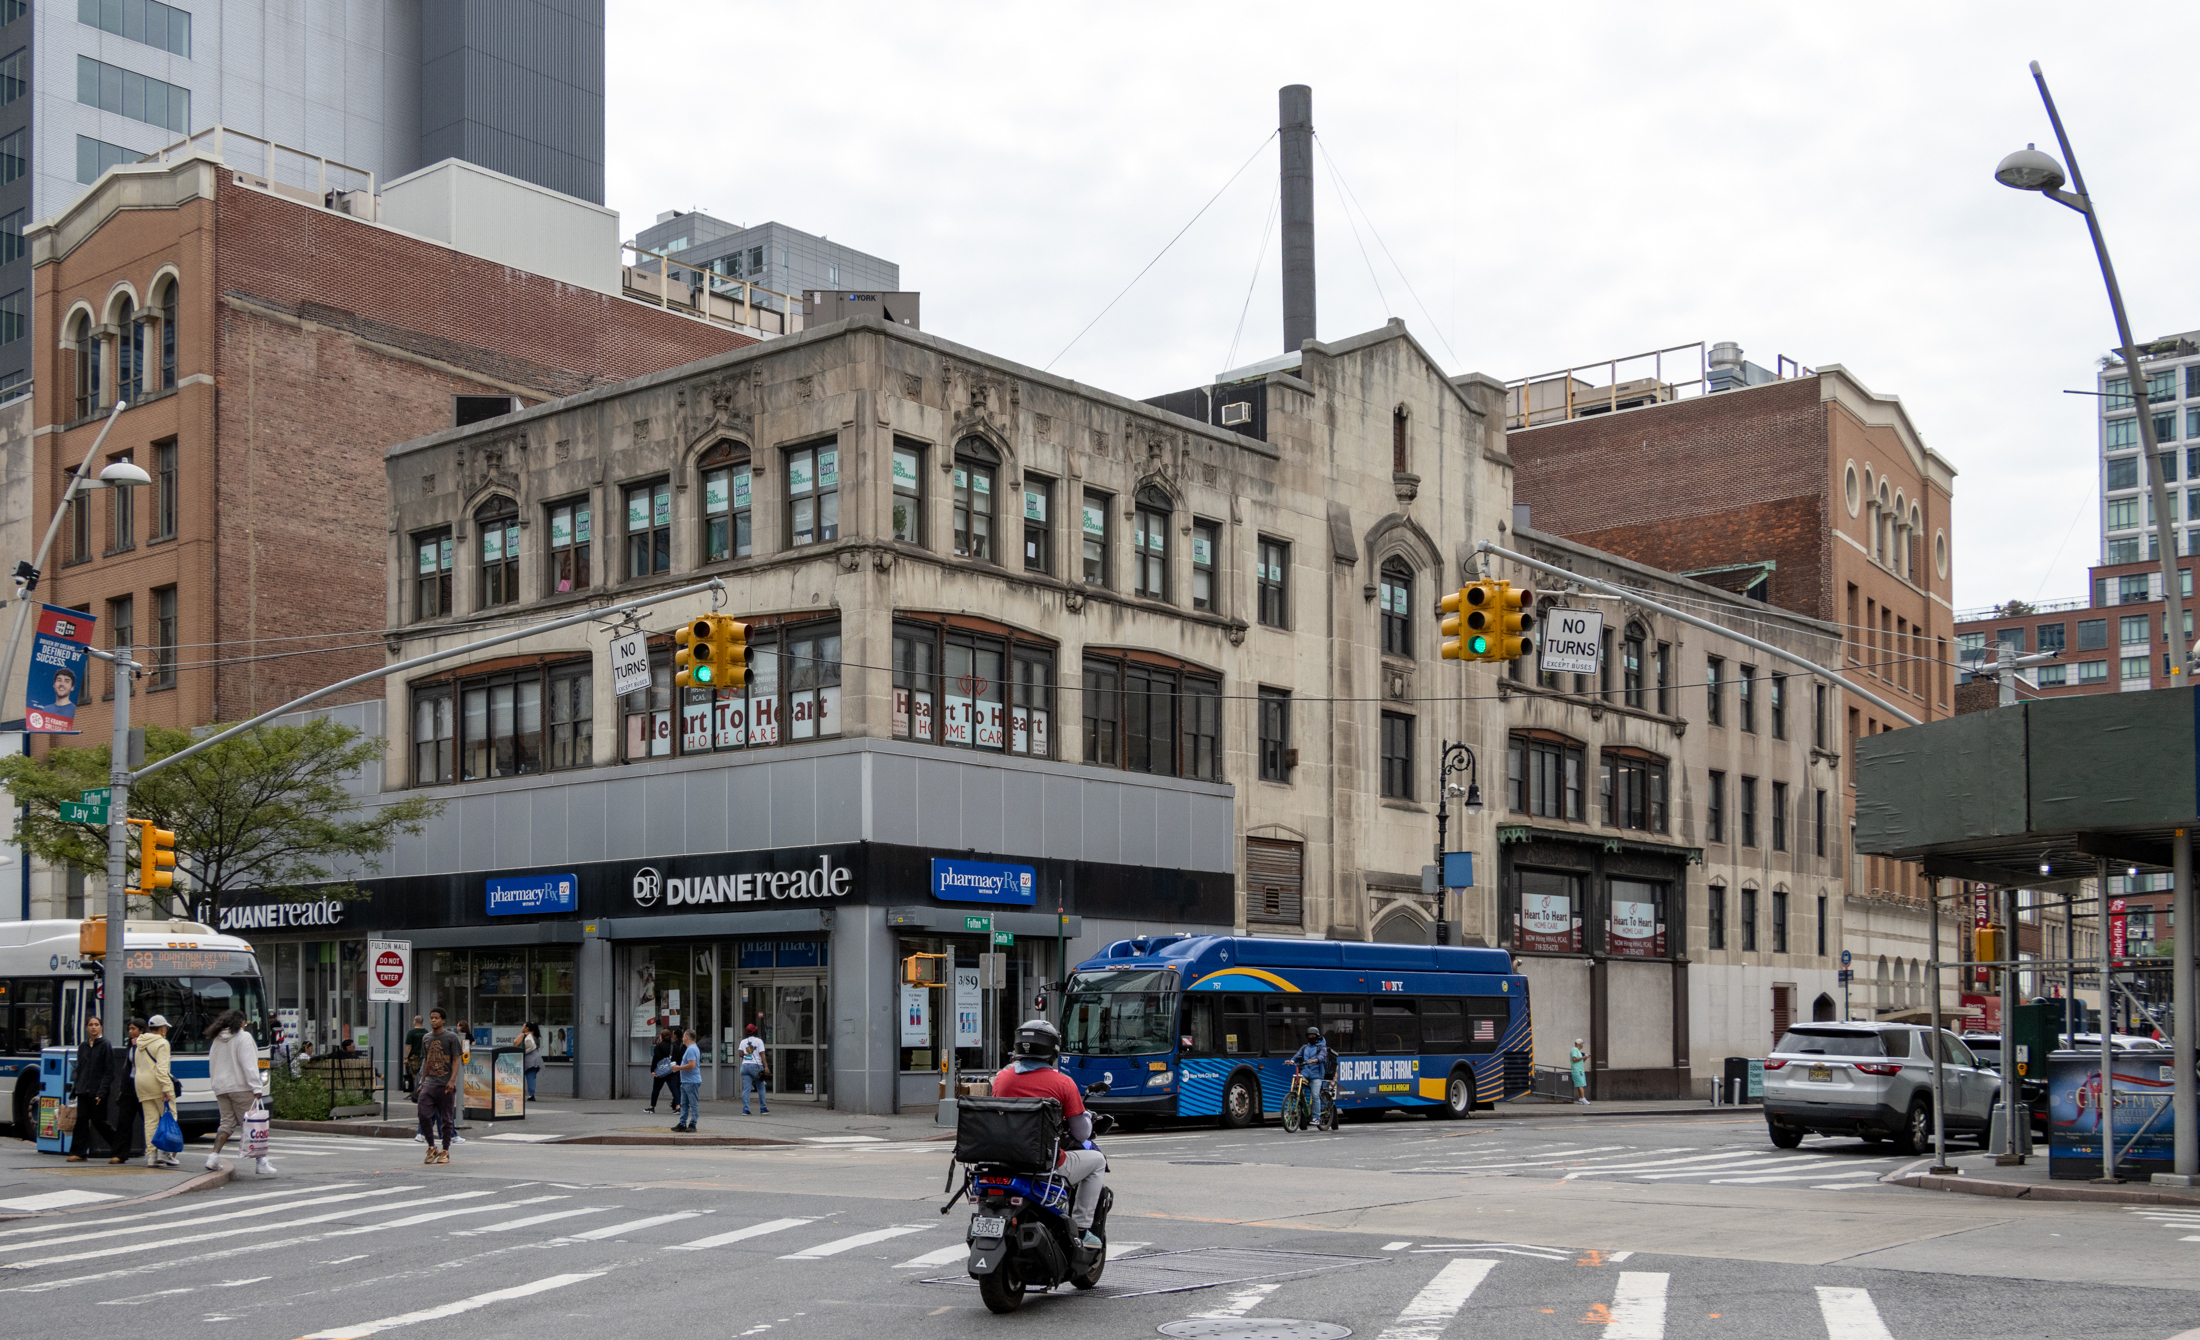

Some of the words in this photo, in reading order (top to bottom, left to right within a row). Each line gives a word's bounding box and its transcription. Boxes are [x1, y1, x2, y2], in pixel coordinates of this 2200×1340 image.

[856, 294, 876, 302] YORK
[820, 453, 835, 465] WORK
[820, 463, 835, 475] GROW
[893, 471, 916, 480] PROGRAM
[1562, 618, 1585, 634] NO
[39, 638, 54, 647] DRIVEN
[54, 640, 60, 648] BY
[1548, 639, 1596, 656] TURNS
[42, 645, 71, 659] DEFINED
[72, 652, 82, 662] BY
[621, 642, 636, 659] NO
[36, 652, 67, 667] SUCCESS.
[615, 659, 647, 679] TURNS
[618, 683, 633, 692] EXCEPT
[634, 679, 647, 687] BUSES
[715, 703, 744, 730] To
[962, 703, 984, 724] To
[991, 706, 1043, 734] Heart
[688, 731, 729, 748] HOME
[736, 726, 776, 743] CARE
[84, 793, 101, 804] Fulton
[71, 806, 88, 822] Jay
[93, 806, 99, 815] St
[633, 875, 660, 899] DR
[1524, 909, 1540, 920] Heart
[1542, 910, 1550, 920] To
[1552, 911, 1567, 921] Heart
[1614, 915, 1628, 926] Heart
[1629, 917, 1636, 926] To
[1638, 917, 1652, 927] Heart
[967, 918, 981, 928] Fulton
[995, 933, 1007, 943] Smith
[1536, 935, 1545, 943] Hiring
[2114, 920, 2123, 957] hick-fil-A
[371, 942, 392, 950] FULTON
[159, 952, 201, 961] DOWNTOWN
[204, 953, 230, 962] BKLYN
[173, 961, 204, 969] TILLARY
[207, 961, 217, 969] ST
[958, 975, 978, 990] 3/$9
[1381, 981, 1386, 991] I
[1340, 1061, 1353, 1080] BIG
[1354, 1061, 1379, 1080] APPLE.
[1380, 1060, 1393, 1079] BIG
[1394, 1060, 1413, 1079] FIRM.
[2066, 1087, 2166, 1112] CHSTMAS
[976, 1223, 999, 1233] 535CE3
